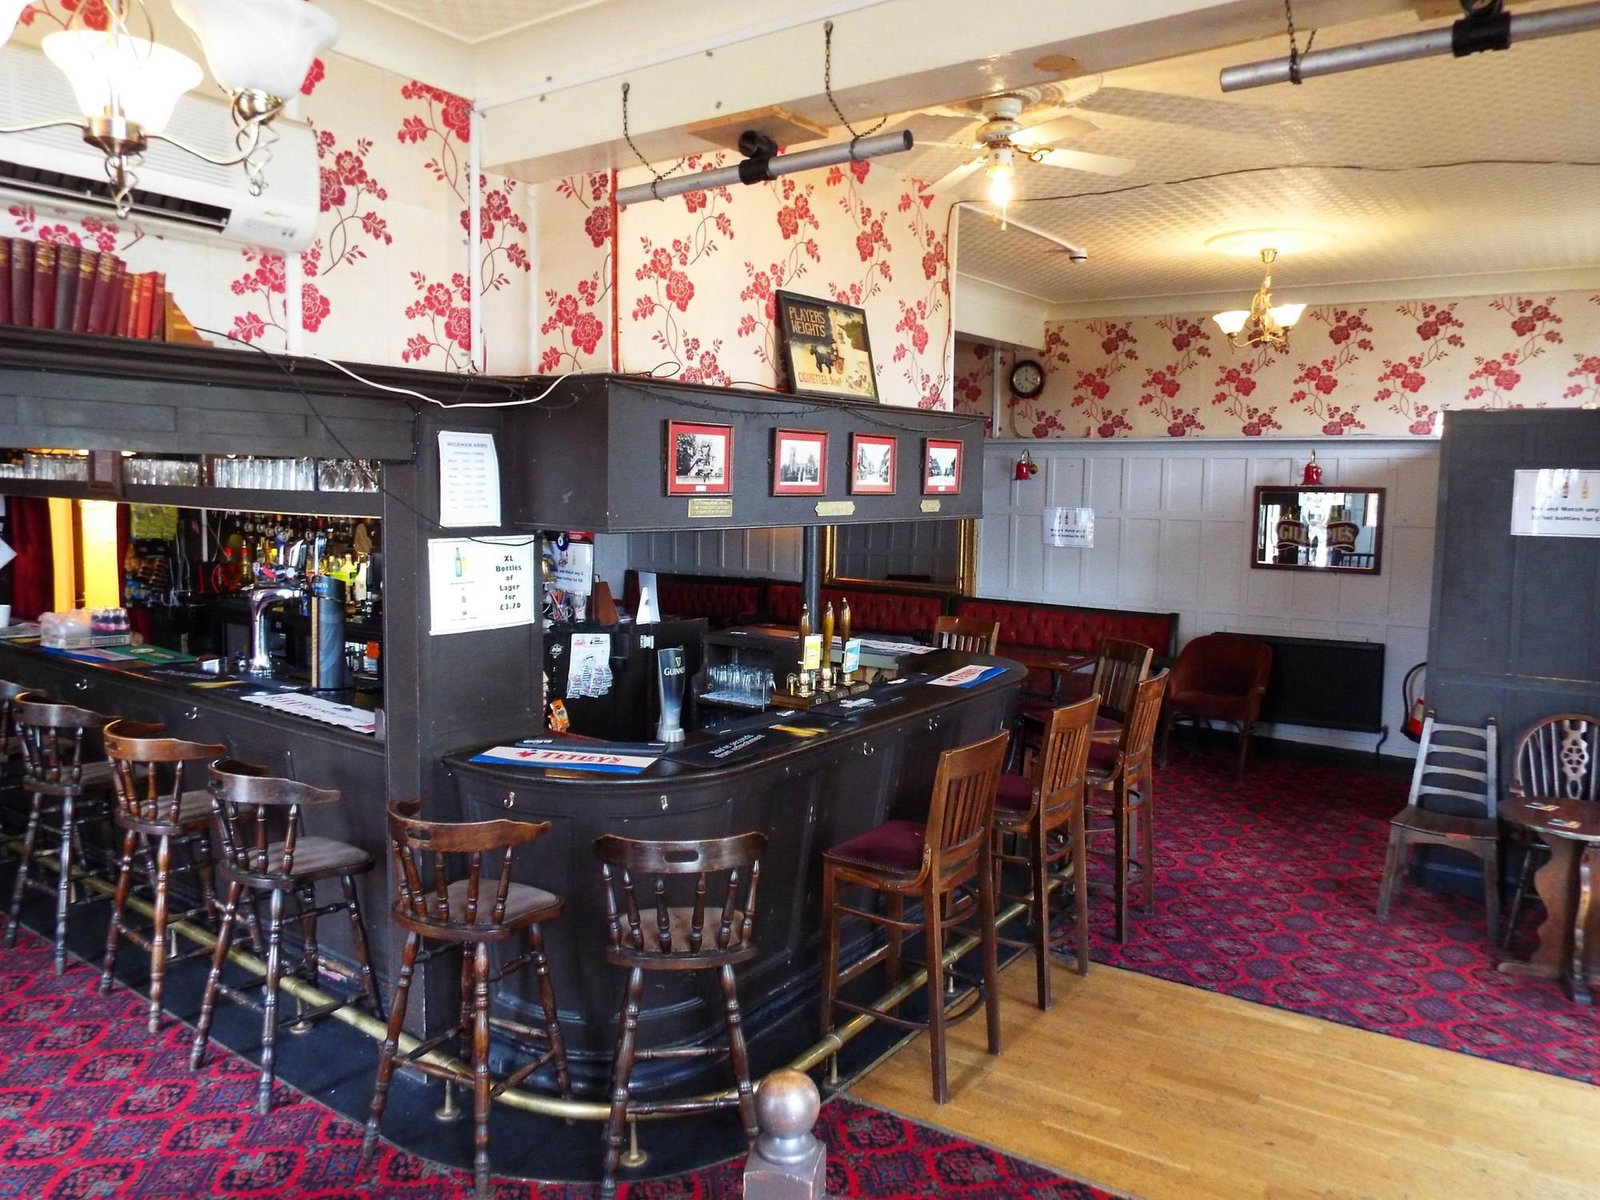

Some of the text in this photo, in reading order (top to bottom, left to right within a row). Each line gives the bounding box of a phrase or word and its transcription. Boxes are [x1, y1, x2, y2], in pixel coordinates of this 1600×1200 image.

[790, 319, 826, 338] WEIGHTS
[495, 564, 522, 573] Bottles
[499, 584, 520, 592] Lager
